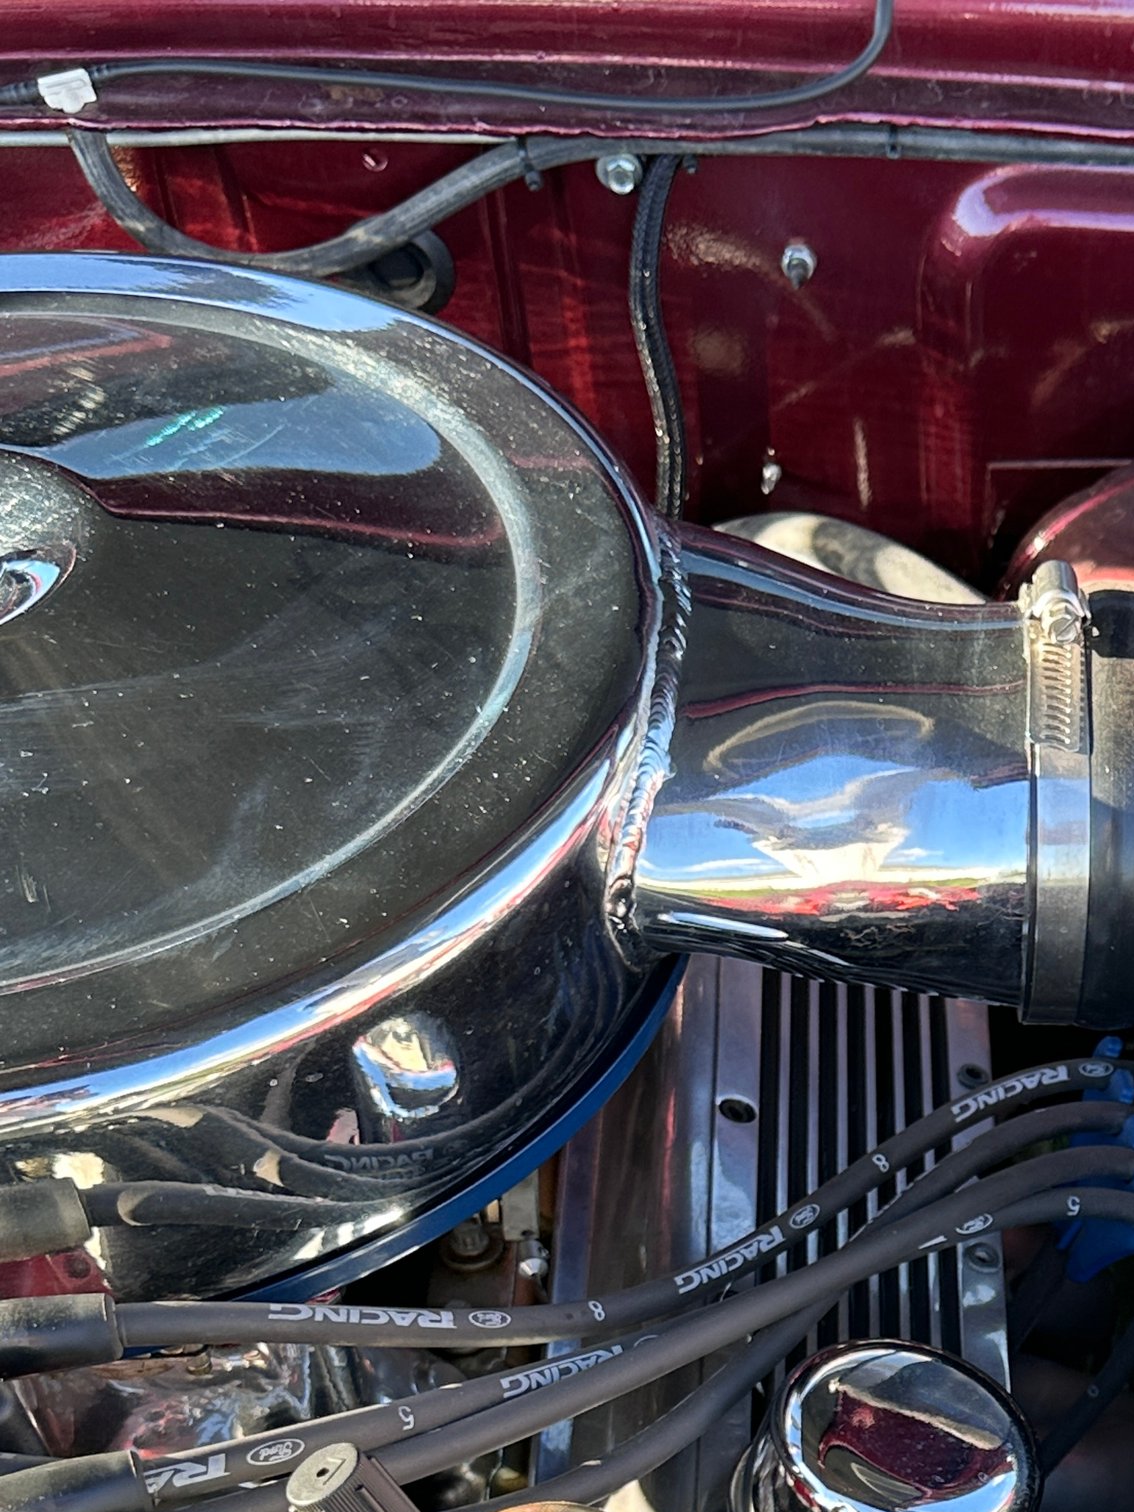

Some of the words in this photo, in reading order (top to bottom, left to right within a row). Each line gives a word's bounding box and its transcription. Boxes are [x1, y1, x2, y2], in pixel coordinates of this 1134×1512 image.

[951, 1065, 1070, 1122] RACING
[871, 1153, 890, 1173] 8
[1066, 1196, 1081, 1216] 5
[674, 1225, 786, 1294] RACING
[268, 1303, 456, 1330] RACING
[588, 1300, 606, 1322] 8
[501, 1344, 624, 1399] RACING
[397, 1405, 415, 1429] 5
[256, 1439, 295, 1462] Ford
